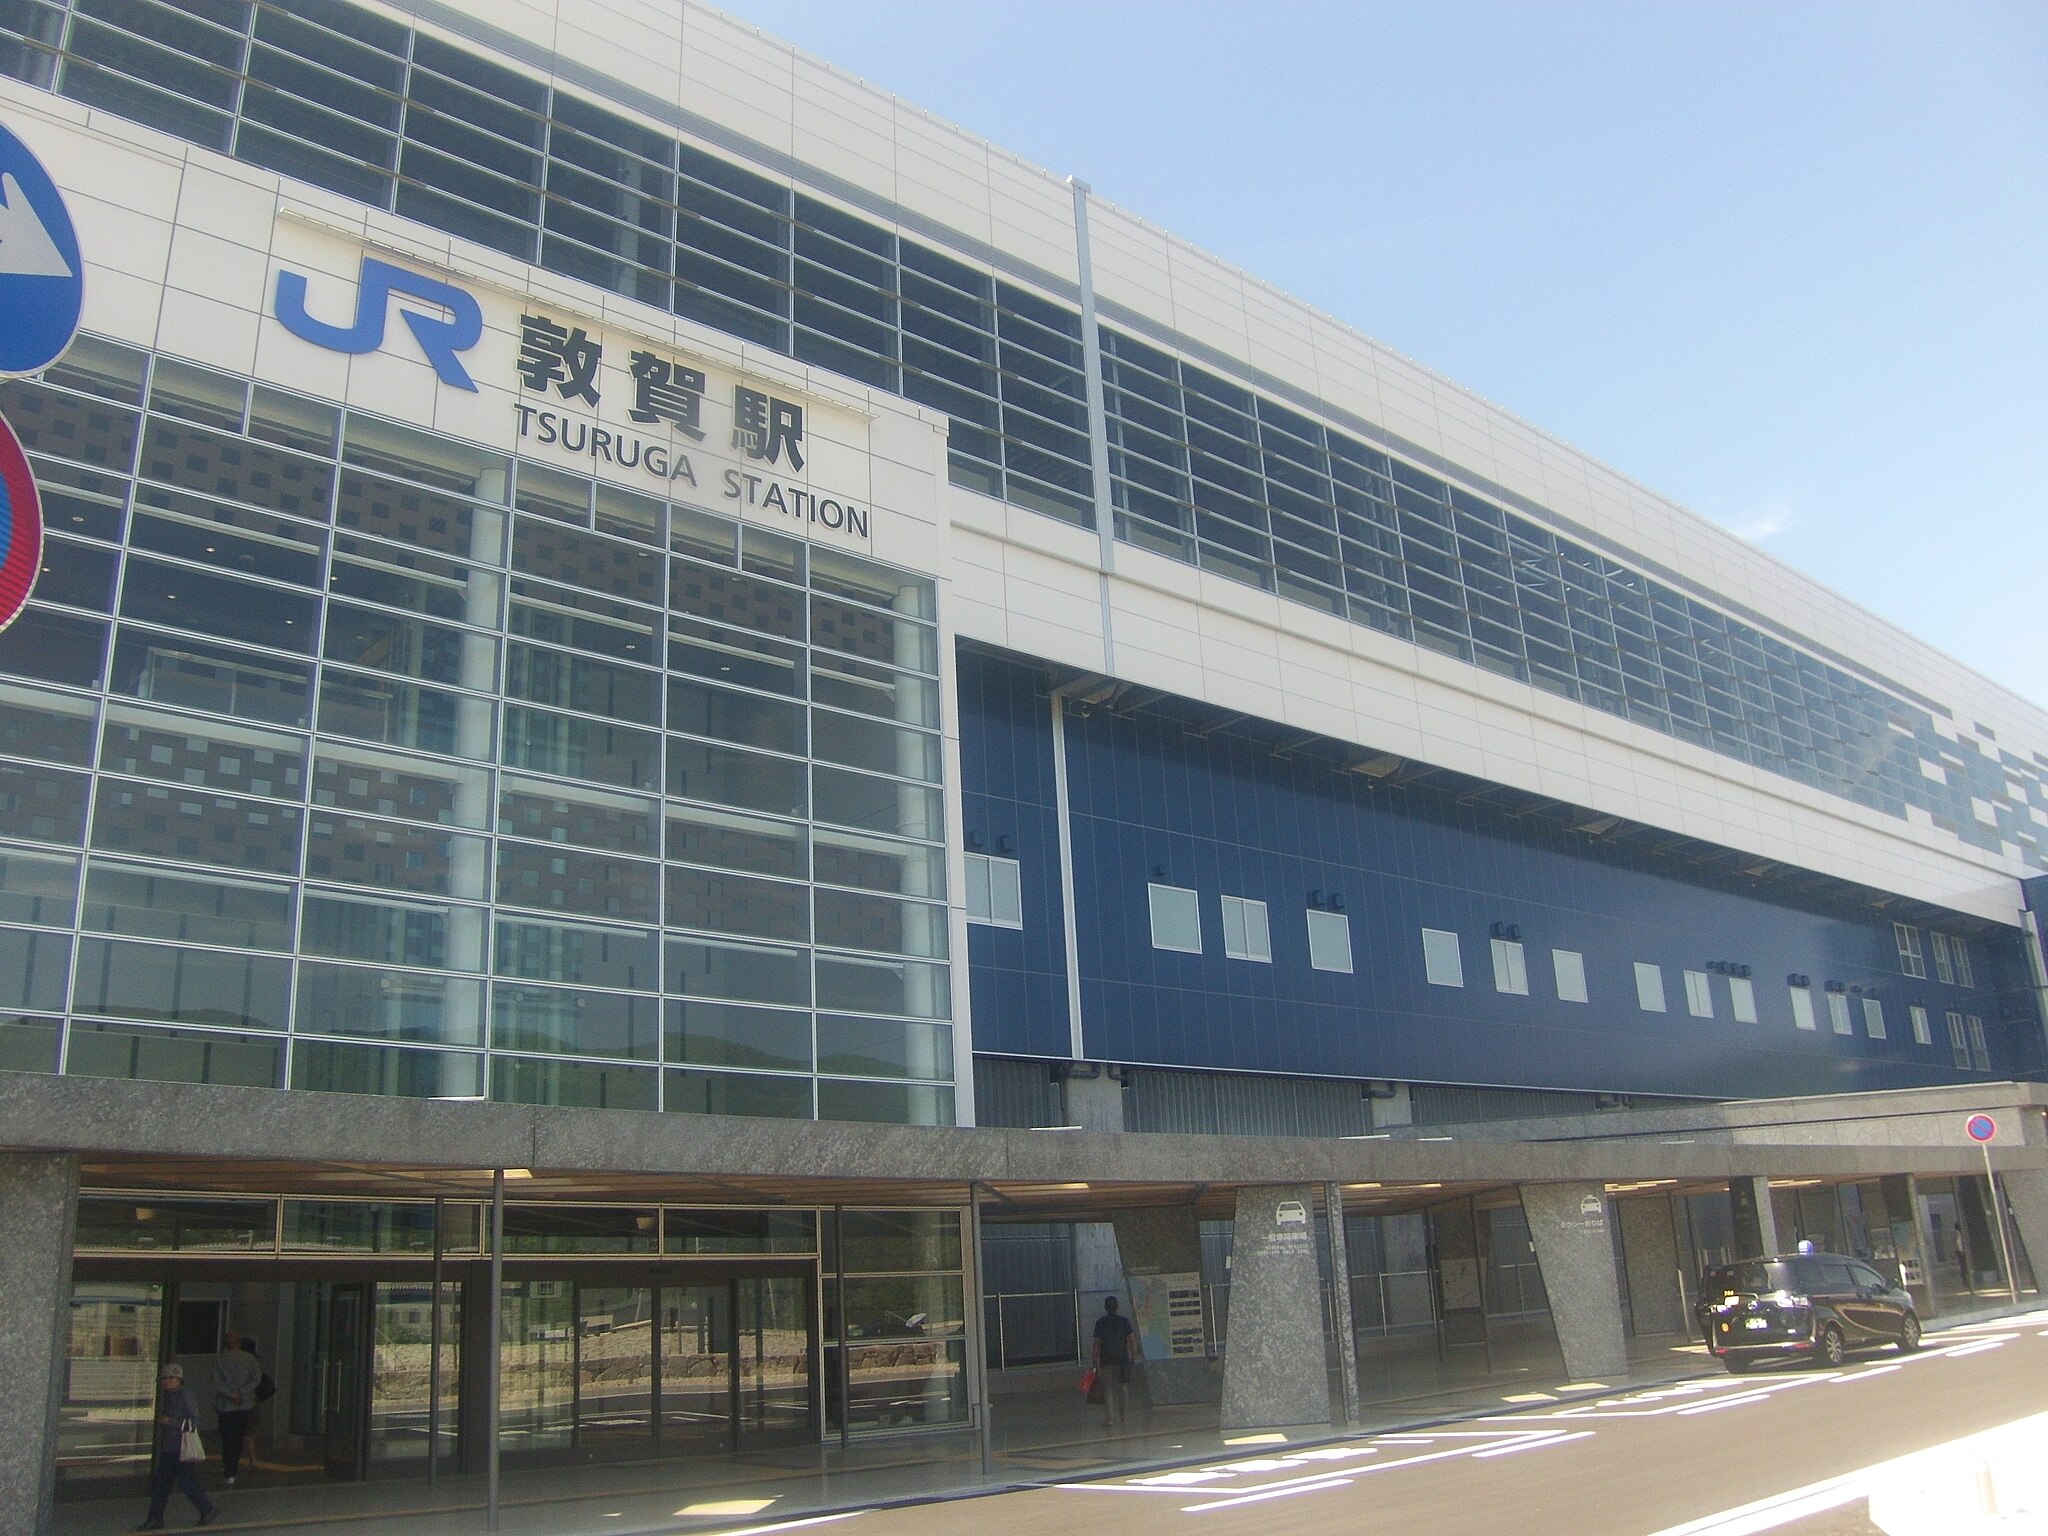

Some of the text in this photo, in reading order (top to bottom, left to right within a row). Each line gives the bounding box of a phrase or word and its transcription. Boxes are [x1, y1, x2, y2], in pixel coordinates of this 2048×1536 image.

[274, 256, 483, 393] JR
[515, 314, 805, 473] 敦賀駅
[513, 402, 868, 538] TSURUGA STATION
